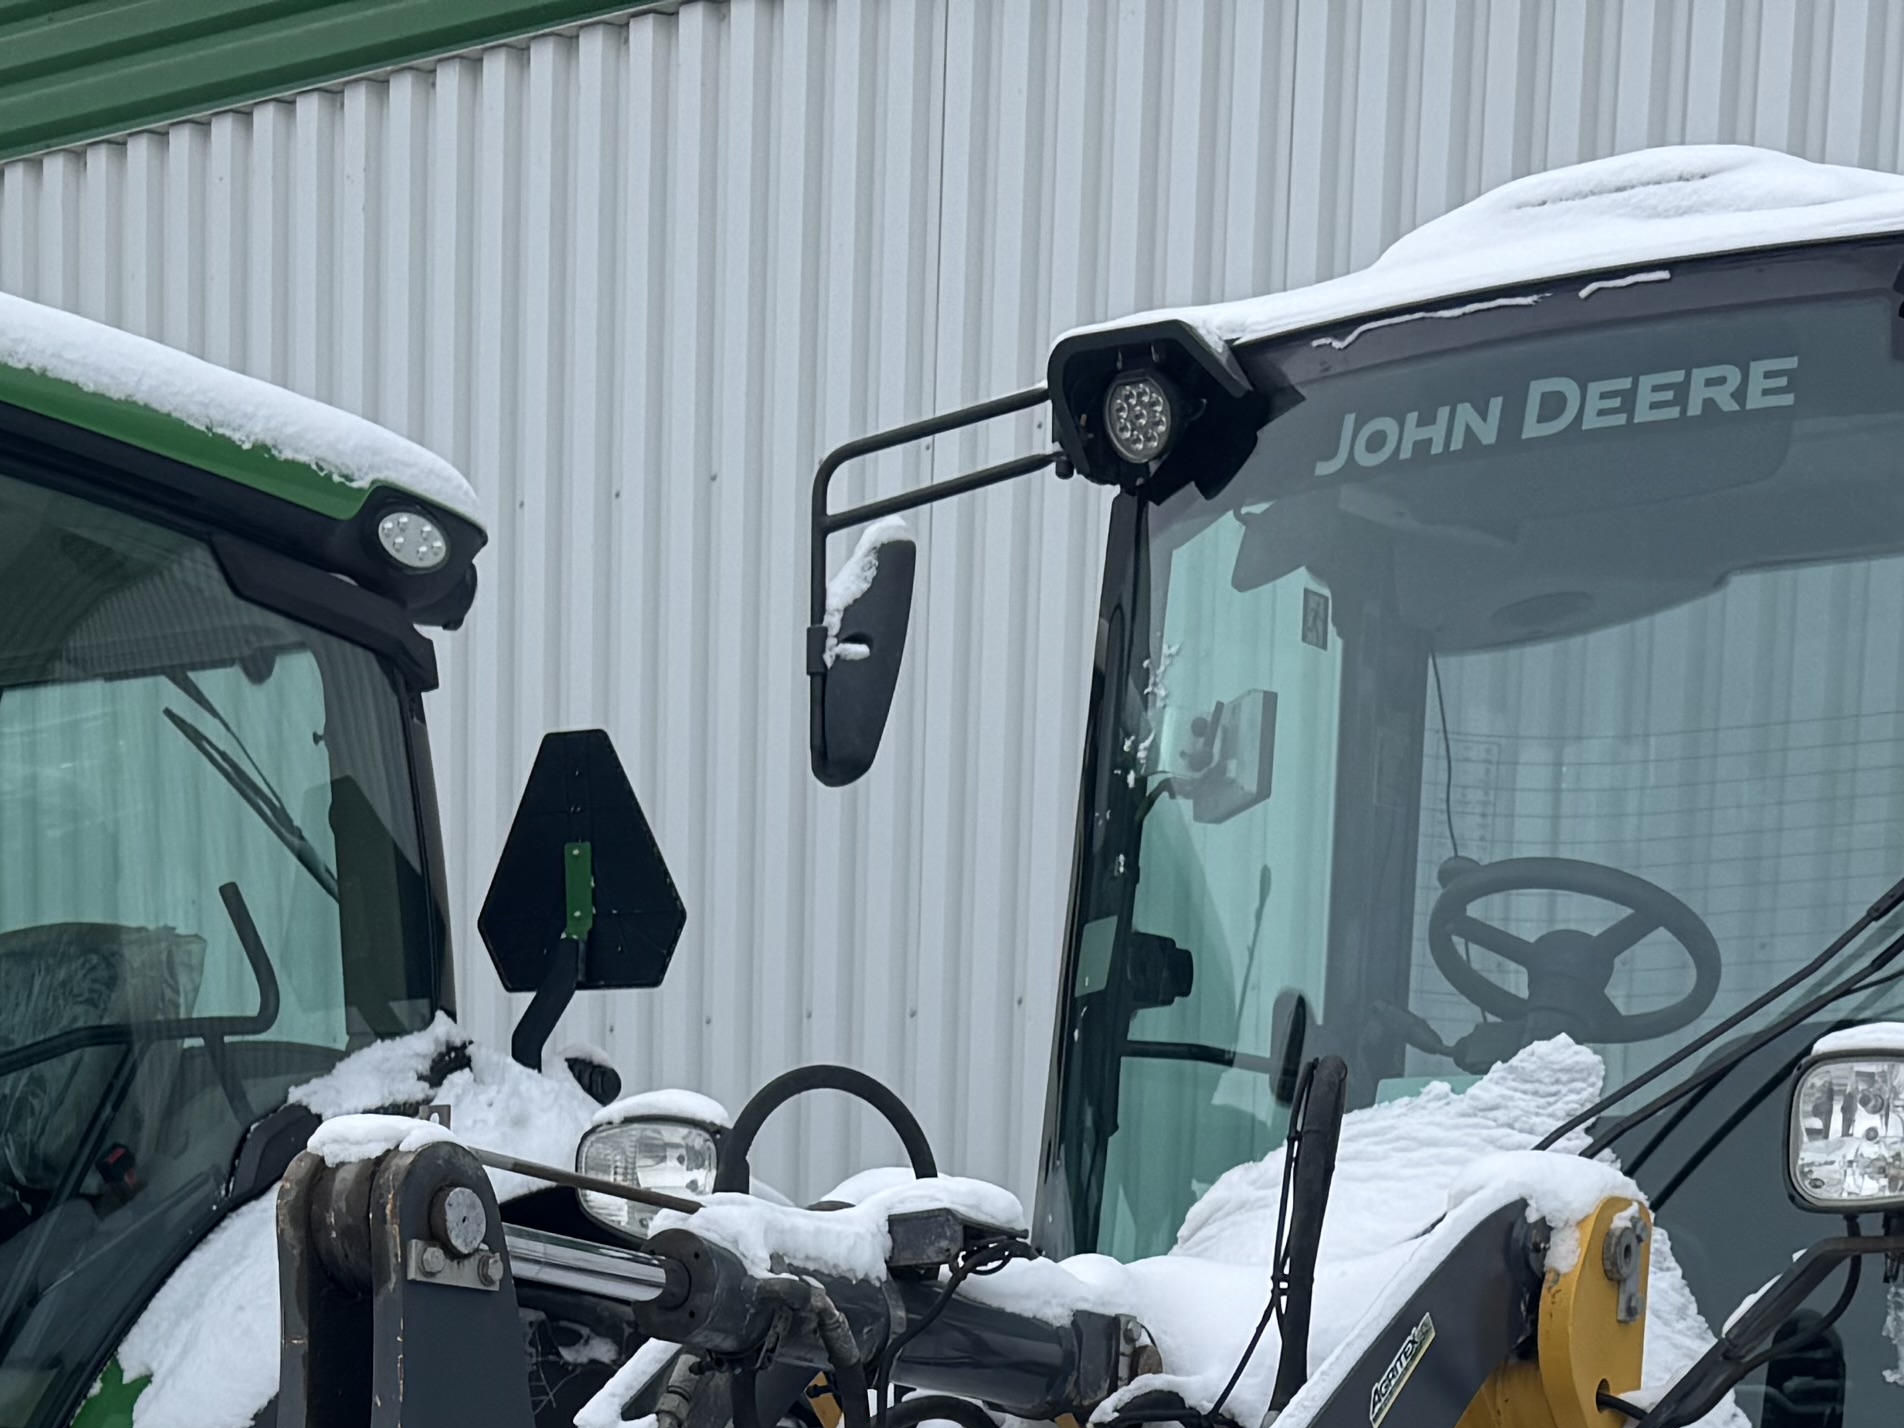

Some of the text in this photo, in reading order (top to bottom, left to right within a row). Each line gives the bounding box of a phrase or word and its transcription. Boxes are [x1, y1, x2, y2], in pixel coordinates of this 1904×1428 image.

[1314, 356, 1799, 476] JOHN DEERE
[1371, 1335, 1419, 1417] AGRITEX
